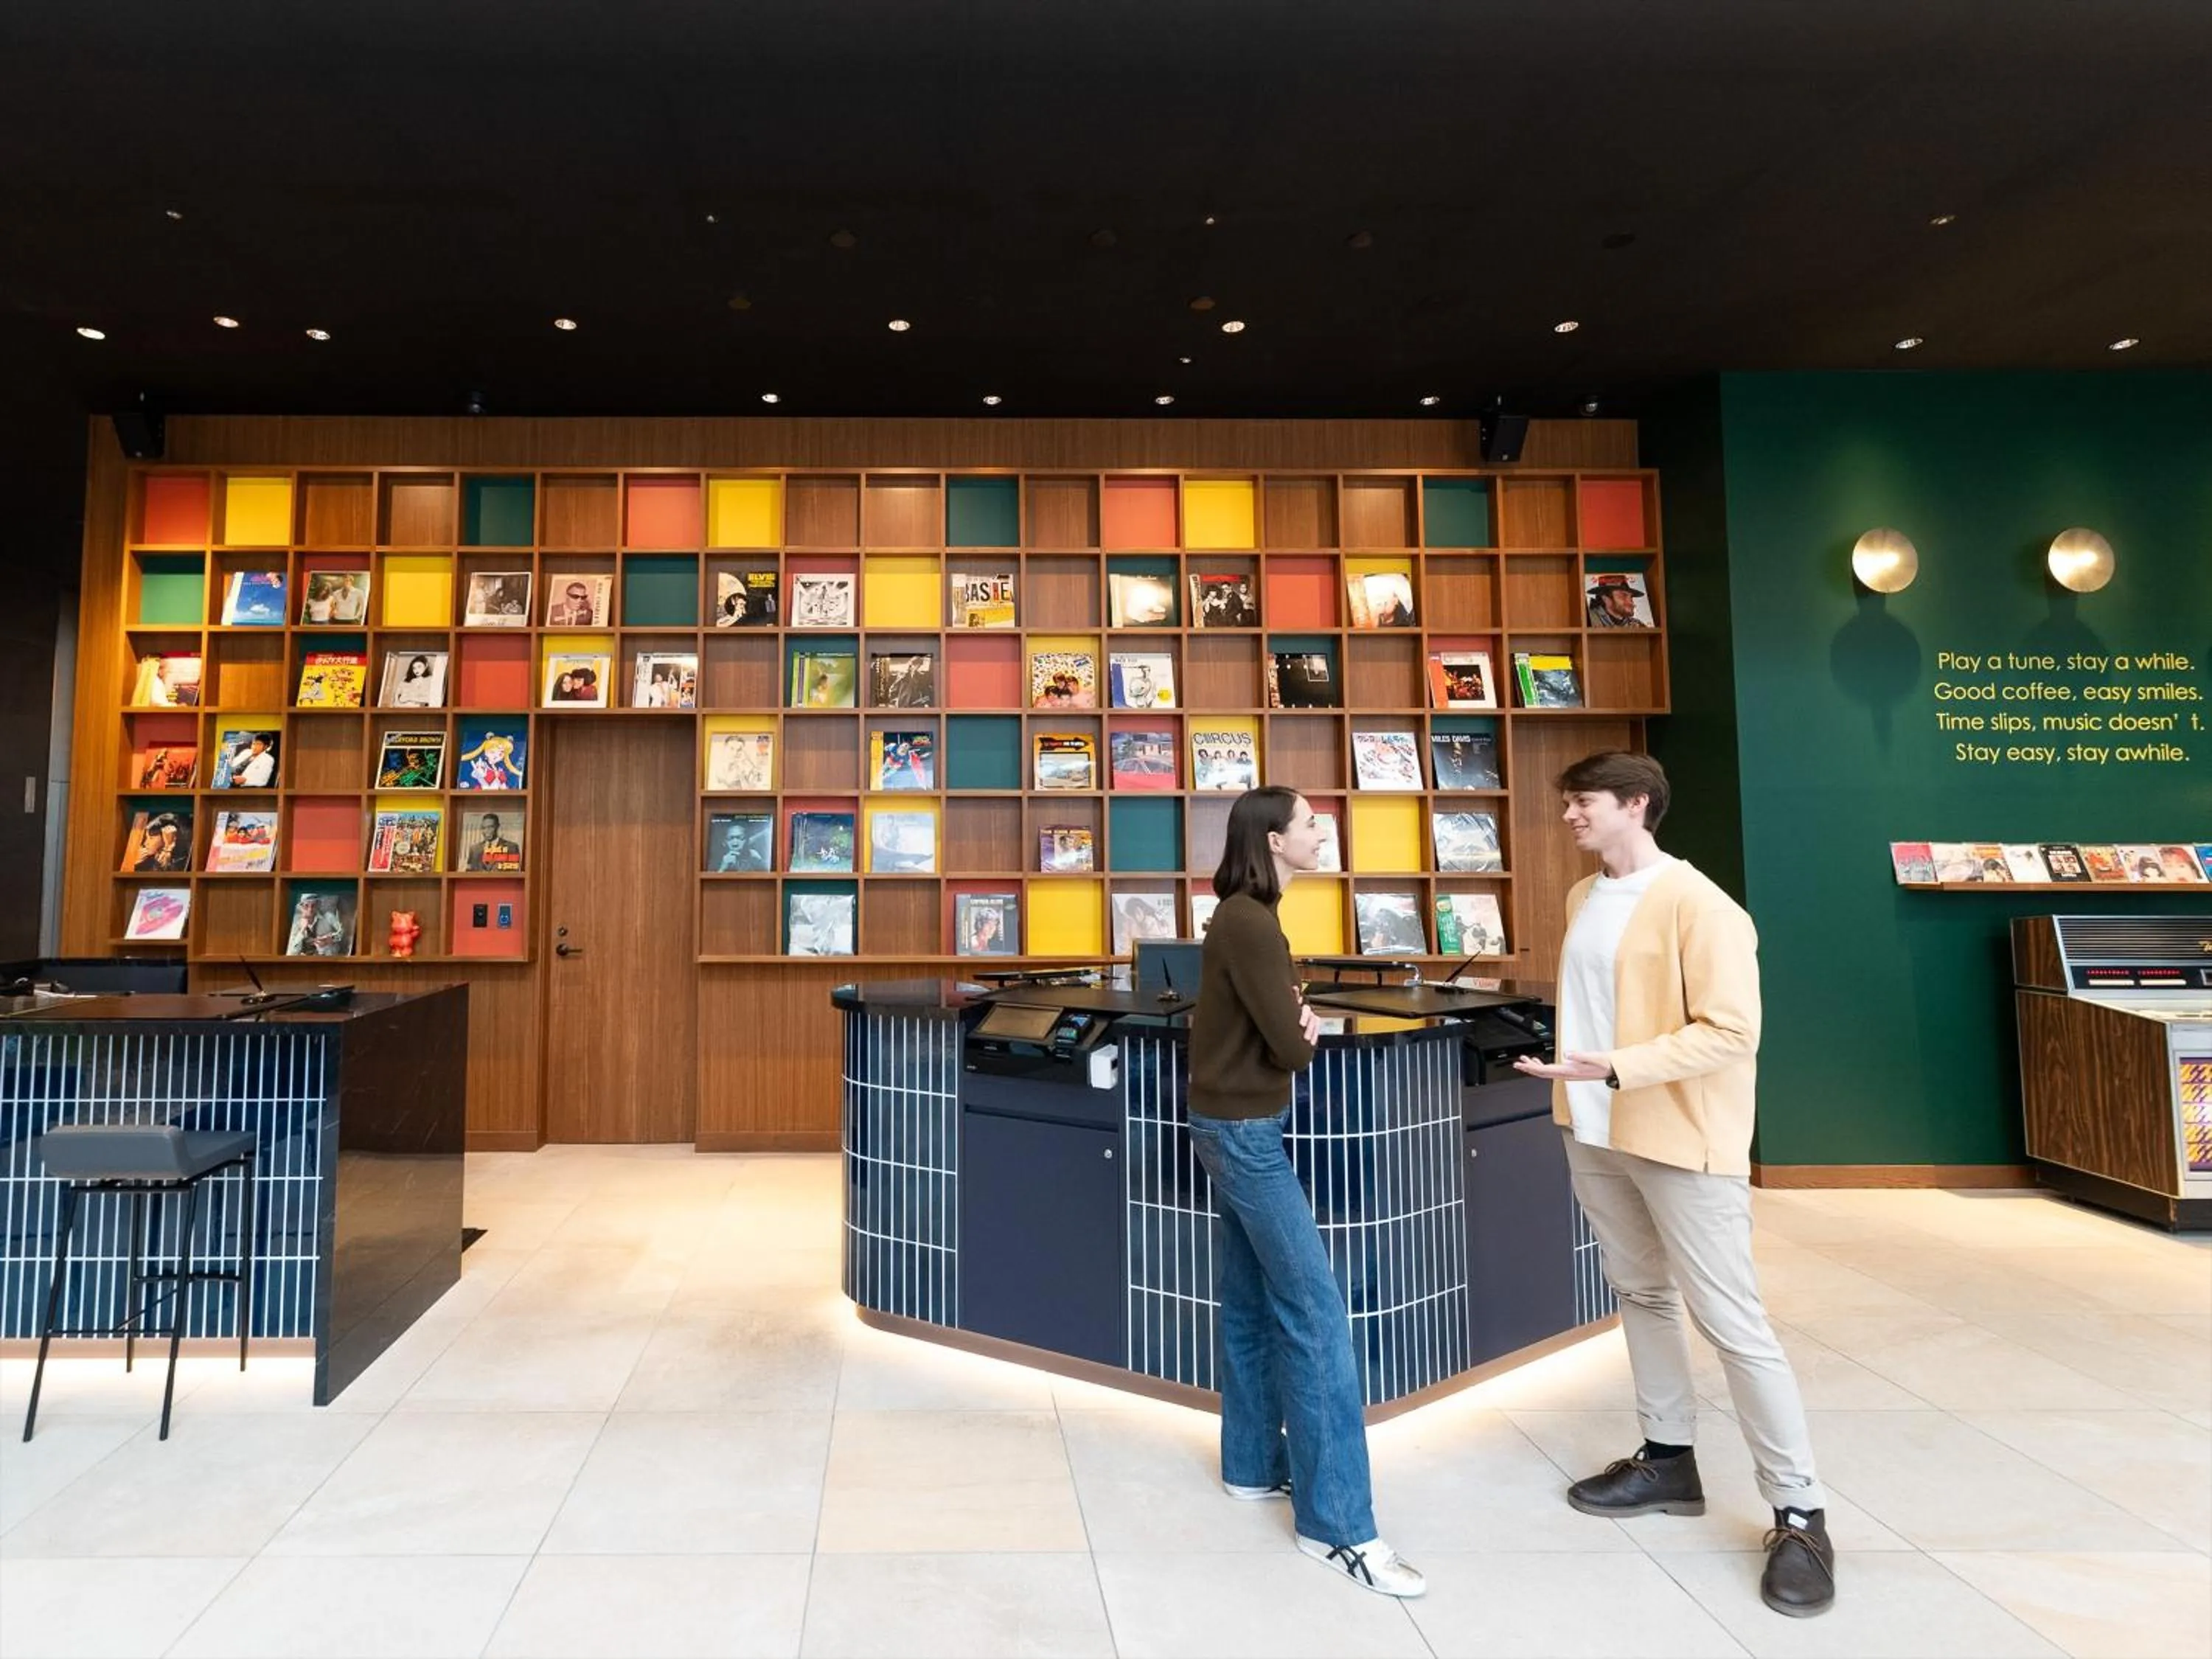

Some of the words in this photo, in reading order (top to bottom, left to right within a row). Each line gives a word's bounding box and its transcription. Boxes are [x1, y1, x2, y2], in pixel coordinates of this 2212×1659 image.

[1938, 652, 1981, 673] Play
[1987, 656, 2002, 670] a
[2008, 653, 2062, 672] tune,
[2067, 653, 2108, 673] stay
[2114, 656, 2129, 670] a
[2135, 653, 2195, 670] while.
[1934, 682, 1996, 700] Good
[2002, 682, 2077, 702] coffee,
[2083, 686, 2132, 704] easy
[2137, 682, 2203, 700] smiles.
[1935, 712, 1985, 731] Time
[1990, 712, 2037, 734] slips,
[2043, 712, 2102, 731] music
[1956, 742, 2000, 765] Stay
[2006, 747, 2062, 765] easy,
[2067, 743, 2110, 765] stay
[2115, 742, 2190, 761] awhile.
